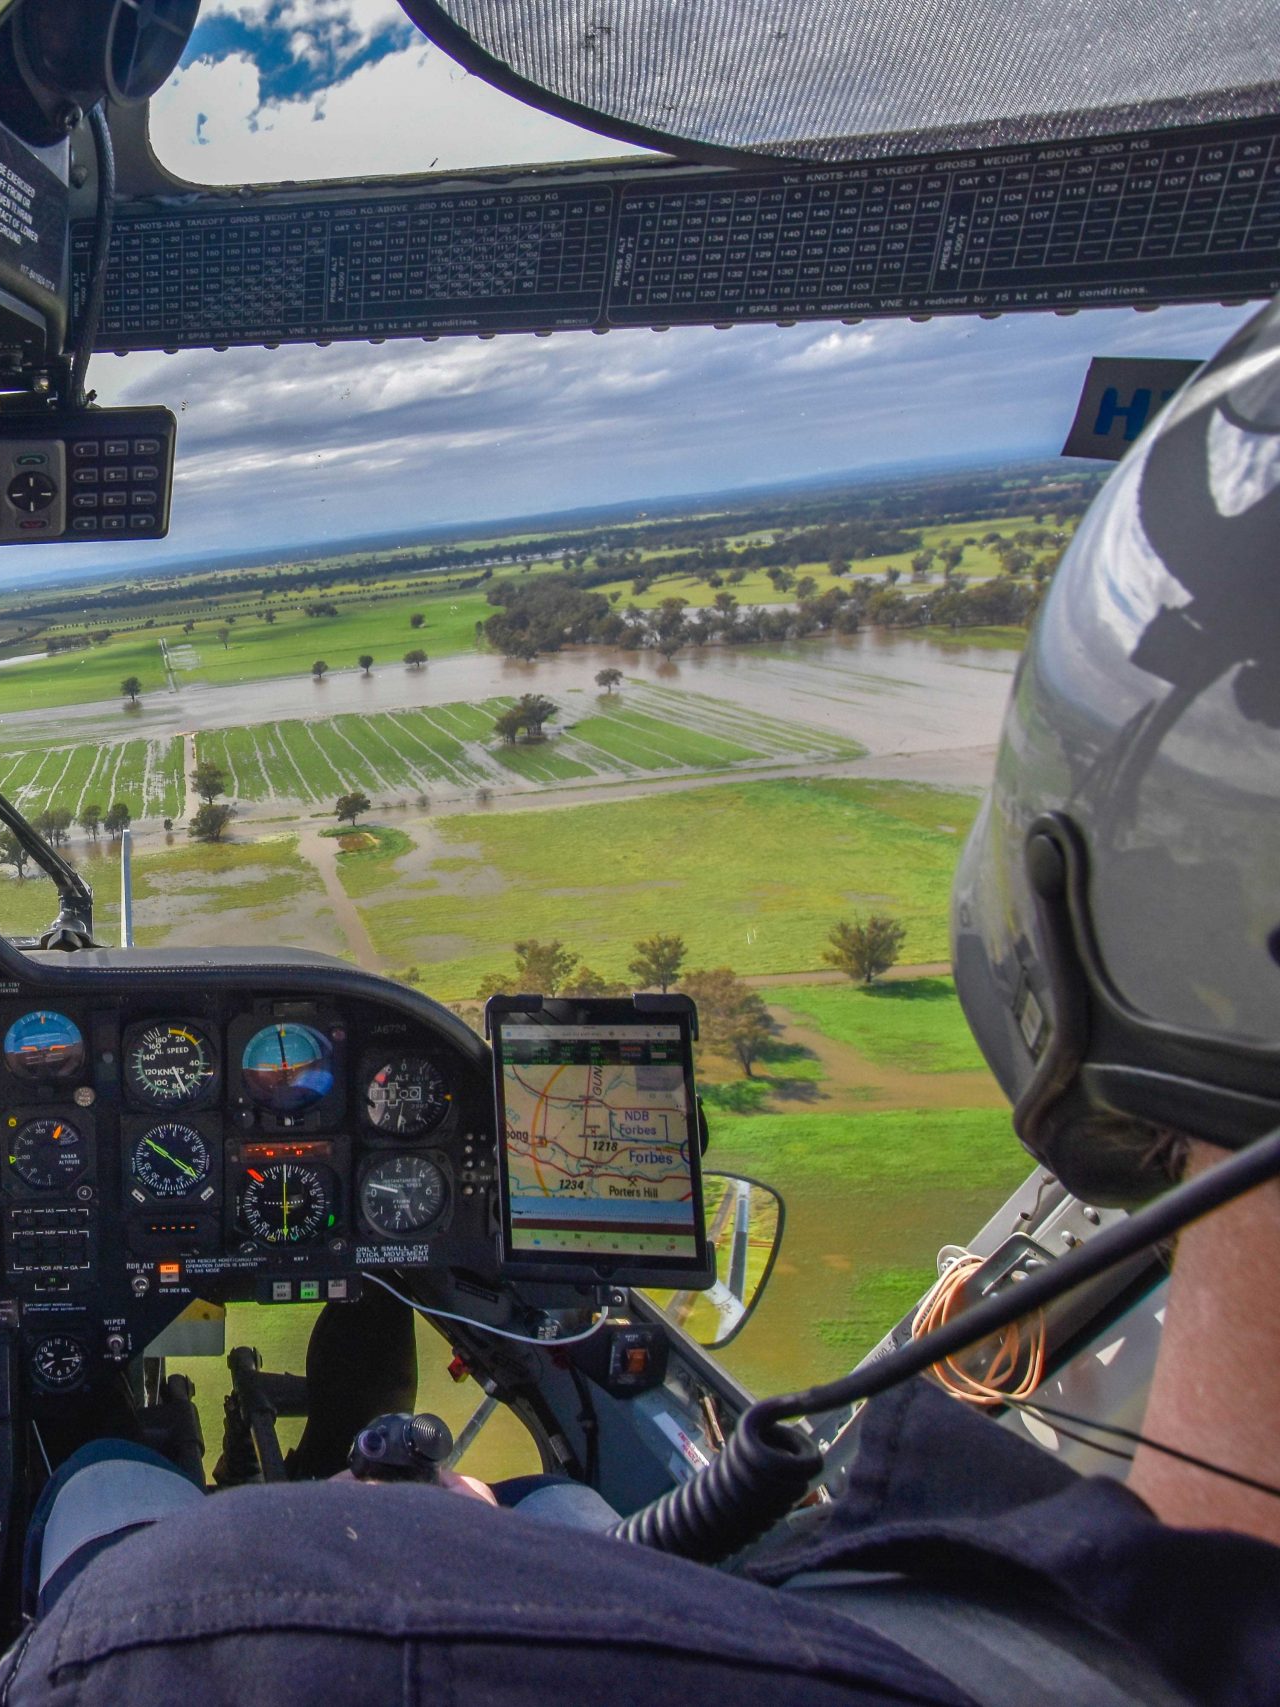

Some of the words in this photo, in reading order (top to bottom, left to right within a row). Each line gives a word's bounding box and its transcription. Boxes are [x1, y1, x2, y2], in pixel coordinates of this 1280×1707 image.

[806, 169, 869, 182] KNOTS-IAS
[875, 163, 928, 177] TAKEOFF
[935, 157, 976, 171] GROSS
[983, 152, 1032, 167] WEIGHT
[1037, 147, 1082, 161] ABOVE
[1089, 142, 1124, 155] 3200
[1130, 139, 1150, 150] KG
[6, 168, 36, 198] EXERCISED
[7, 182, 23, 202] FROM
[21, 195, 31, 209] OR
[186, 217, 225, 227] TAKEOFF
[230, 215, 260, 225] GROSS
[264, 212, 297, 222] WEIGHT
[302, 211, 314, 220] UP
[320, 209, 330, 218] TO
[440, 200, 454, 209] KG
[458, 198, 478, 208] AND
[482, 197, 495, 206] UP
[500, 195, 513, 204] TO
[545, 192, 559, 201] KG
[12, 214, 21, 229] OF
[20, 221, 39, 243] LOWER
[749, 304, 778, 314] SPAS
[783, 303, 800, 313] not
[880, 298, 903, 308] VNE
[922, 295, 967, 306] reduced
[166, 1046, 189, 1054] SPEED
[624, 1111, 649, 1121] NDB
[620, 1124, 657, 1135] Forbes
[593, 1141, 618, 1151] 1218
[629, 1152, 673, 1164] Forbes
[559, 1179, 584, 1190] 1234
[609, 1186, 641, 1198] Porters
[643, 1187, 659, 1198] Hill
